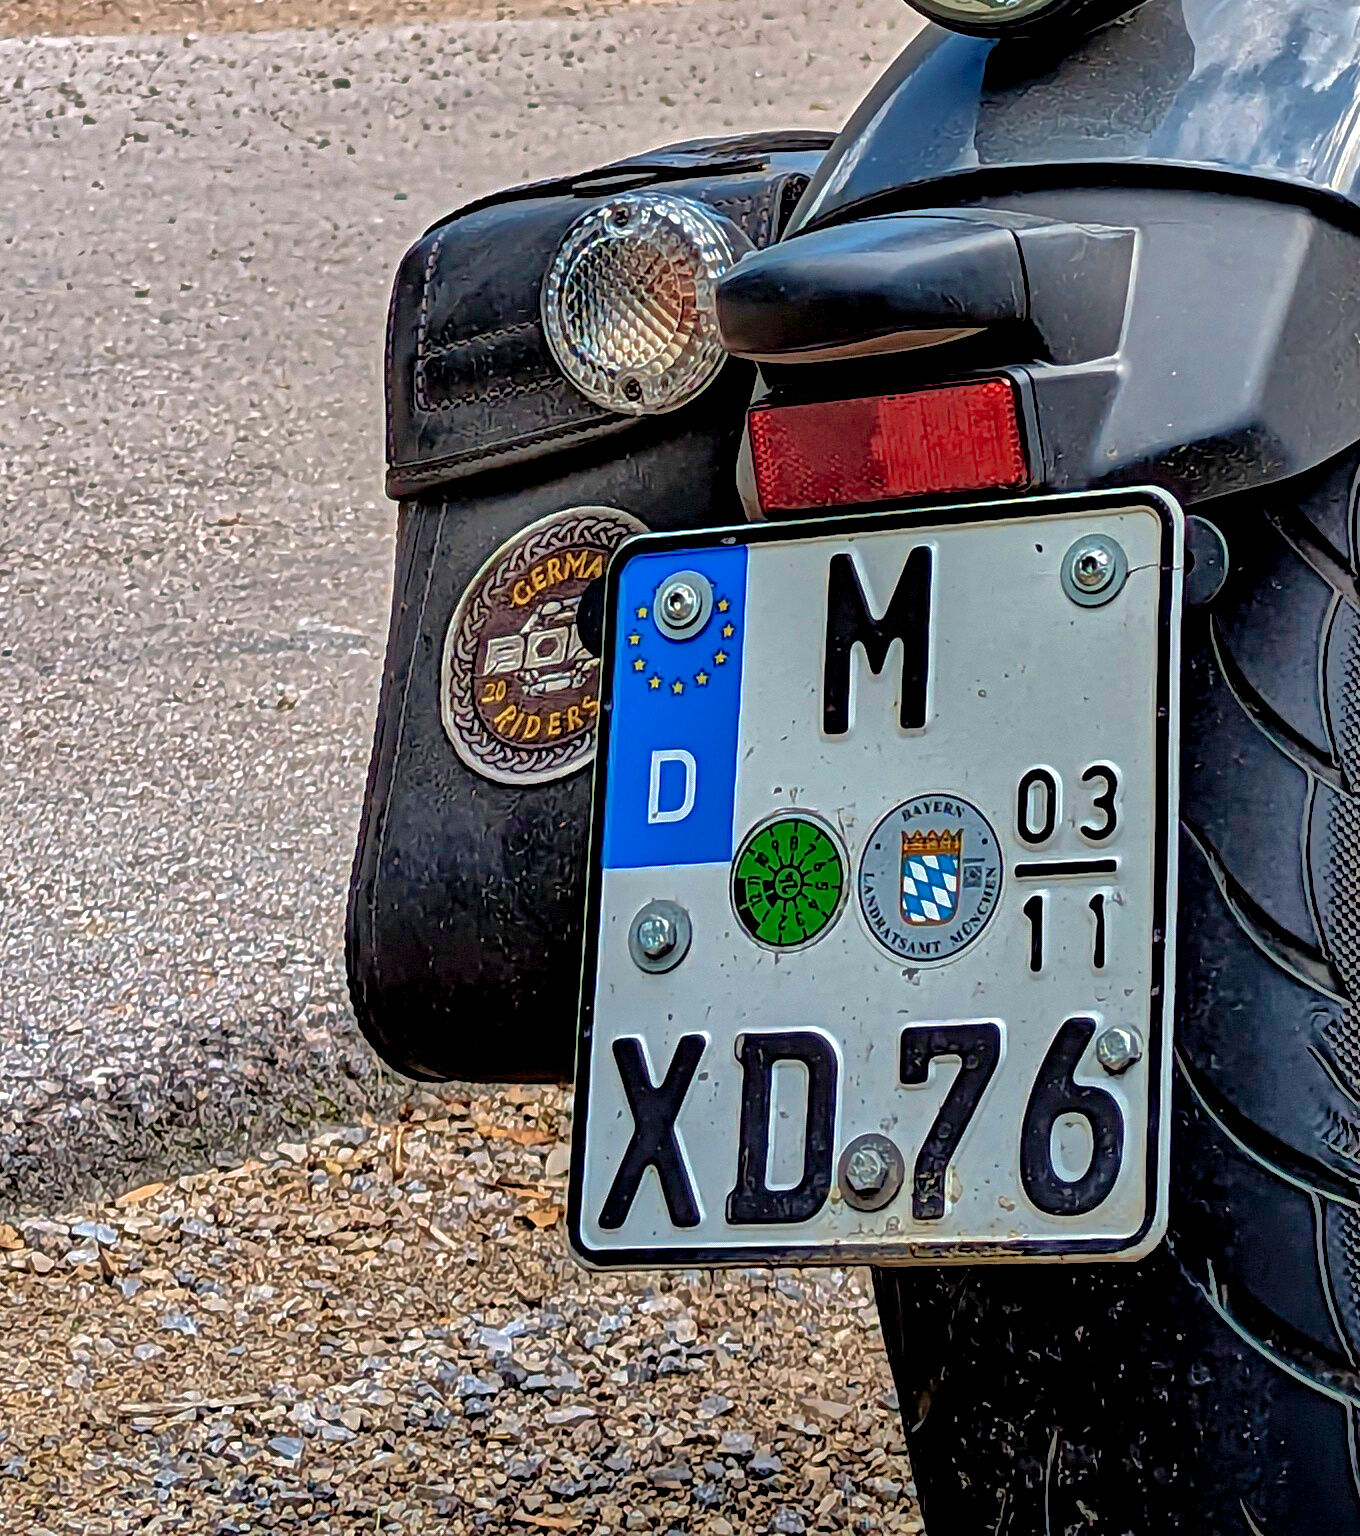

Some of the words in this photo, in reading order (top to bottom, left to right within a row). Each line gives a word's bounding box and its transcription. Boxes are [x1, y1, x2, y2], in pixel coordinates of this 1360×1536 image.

[511, 549, 604, 607] GERMA
[822, 545, 933, 736] M
[494, 696, 599, 741] RIDERS
[648, 749, 698, 825] D
[902, 801, 966, 822] BAYERN
[1016, 767, 1119, 844] 03
[864, 872, 941, 954] LANDRATSAMT
[1022, 893, 1107, 974] 11
[598, 1031, 840, 1230] XD
[899, 1017, 1124, 1221] 76
